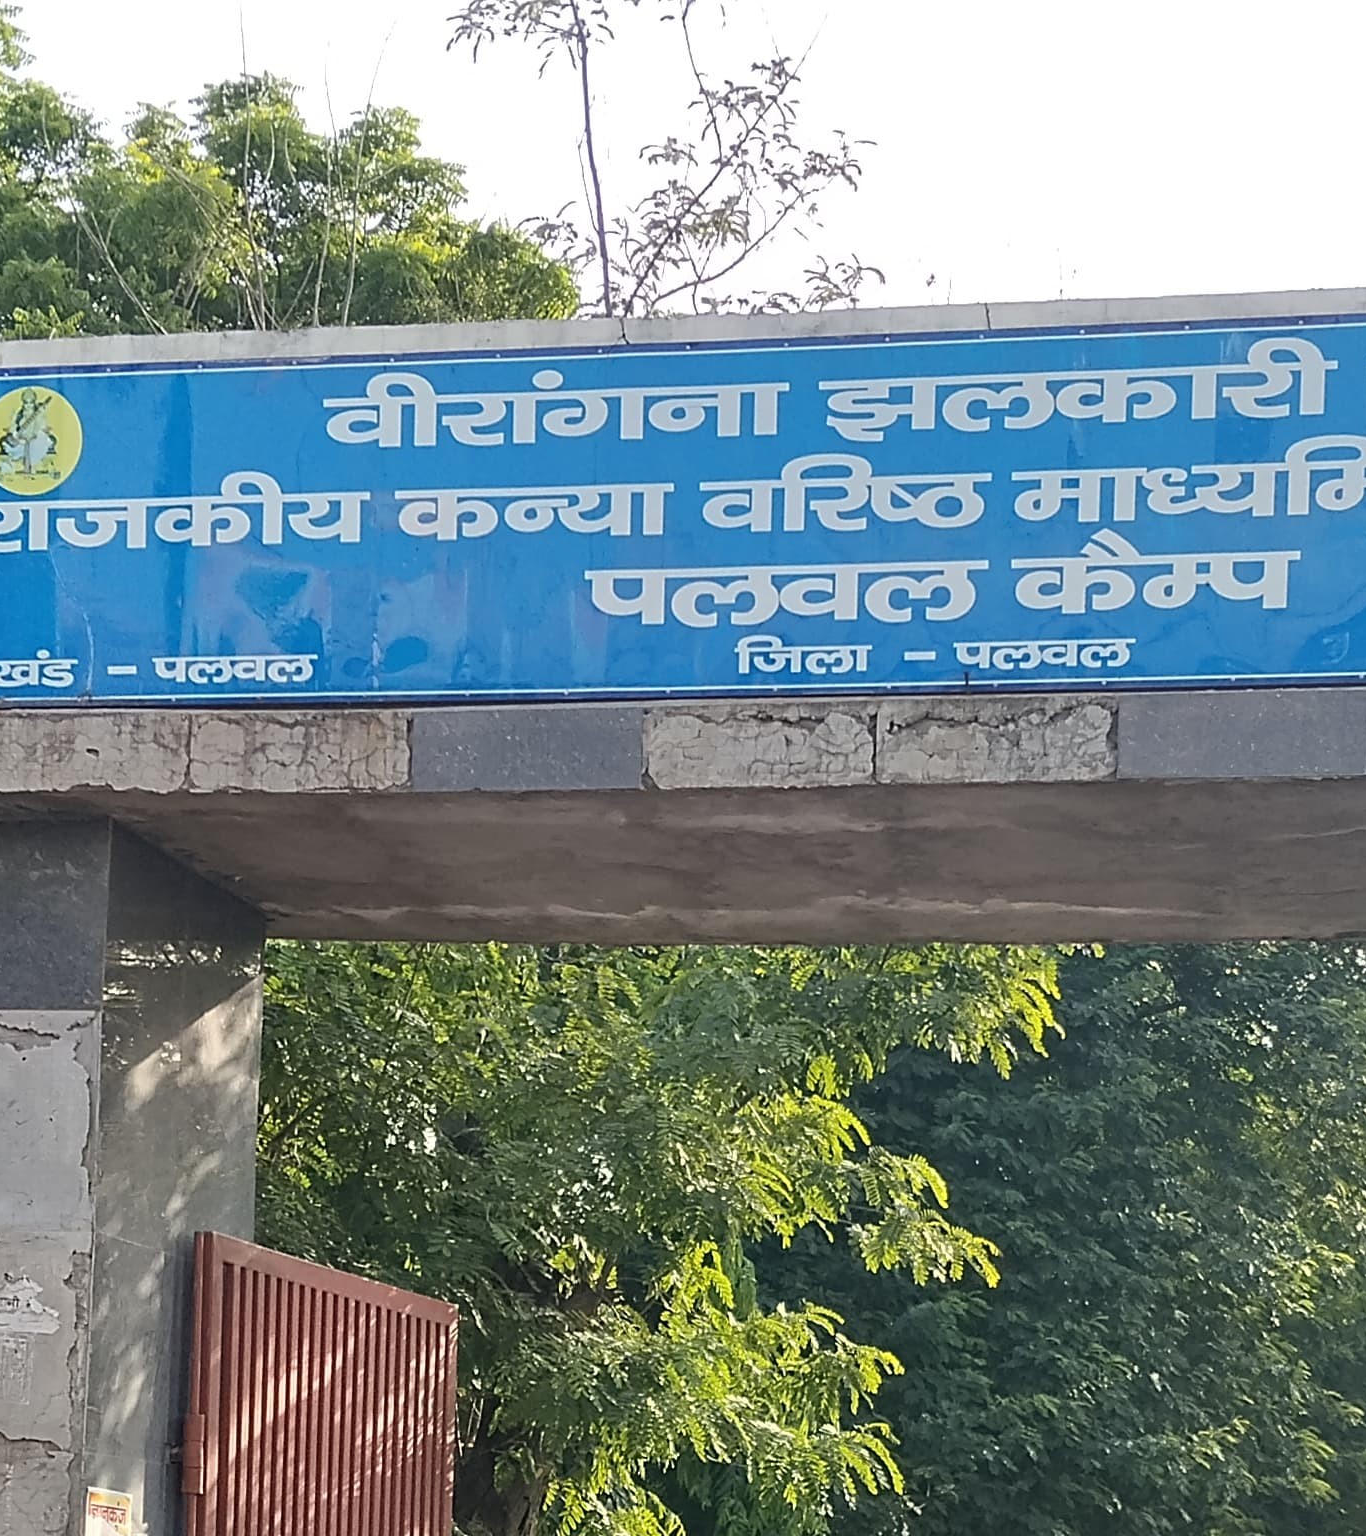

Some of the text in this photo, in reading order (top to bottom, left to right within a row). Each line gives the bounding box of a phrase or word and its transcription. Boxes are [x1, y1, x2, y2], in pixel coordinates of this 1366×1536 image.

[324, 370, 788, 448] वीरांगना
[825, 336, 1337, 443] झलकारी
[394, 483, 674, 541] कन्या
[700, 451, 991, 534] वरिष्ठ
[584, 527, 1300, 628] पलवल कैम्प
[151, 653, 317, 684] पलवल
[735, 634, 871, 676] जिला
[954, 636, 1134, 670] पलवल
